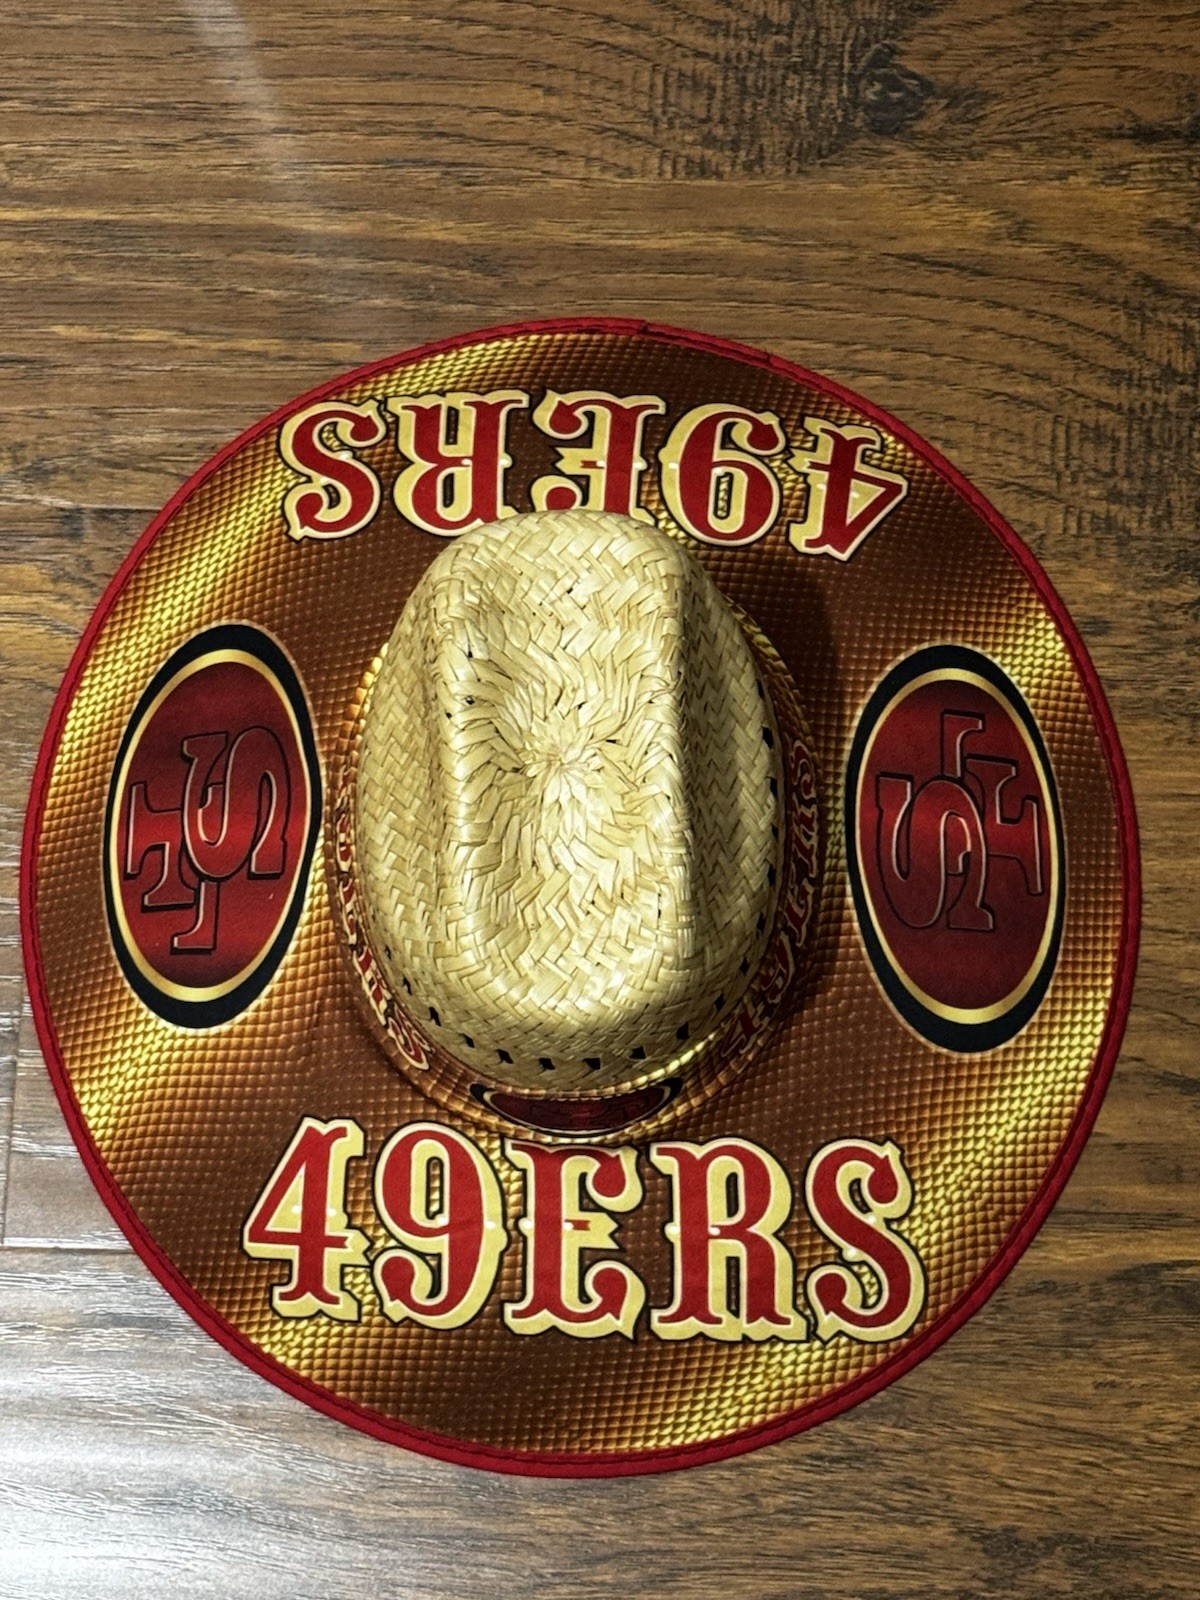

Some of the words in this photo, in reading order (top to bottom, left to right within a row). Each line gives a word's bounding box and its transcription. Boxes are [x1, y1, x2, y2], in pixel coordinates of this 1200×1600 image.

[279, 389, 909, 561] 49ERS
[123, 726, 290, 954] SF
[876, 709, 1043, 932] SF
[243, 1116, 926, 1341] 49ERS
